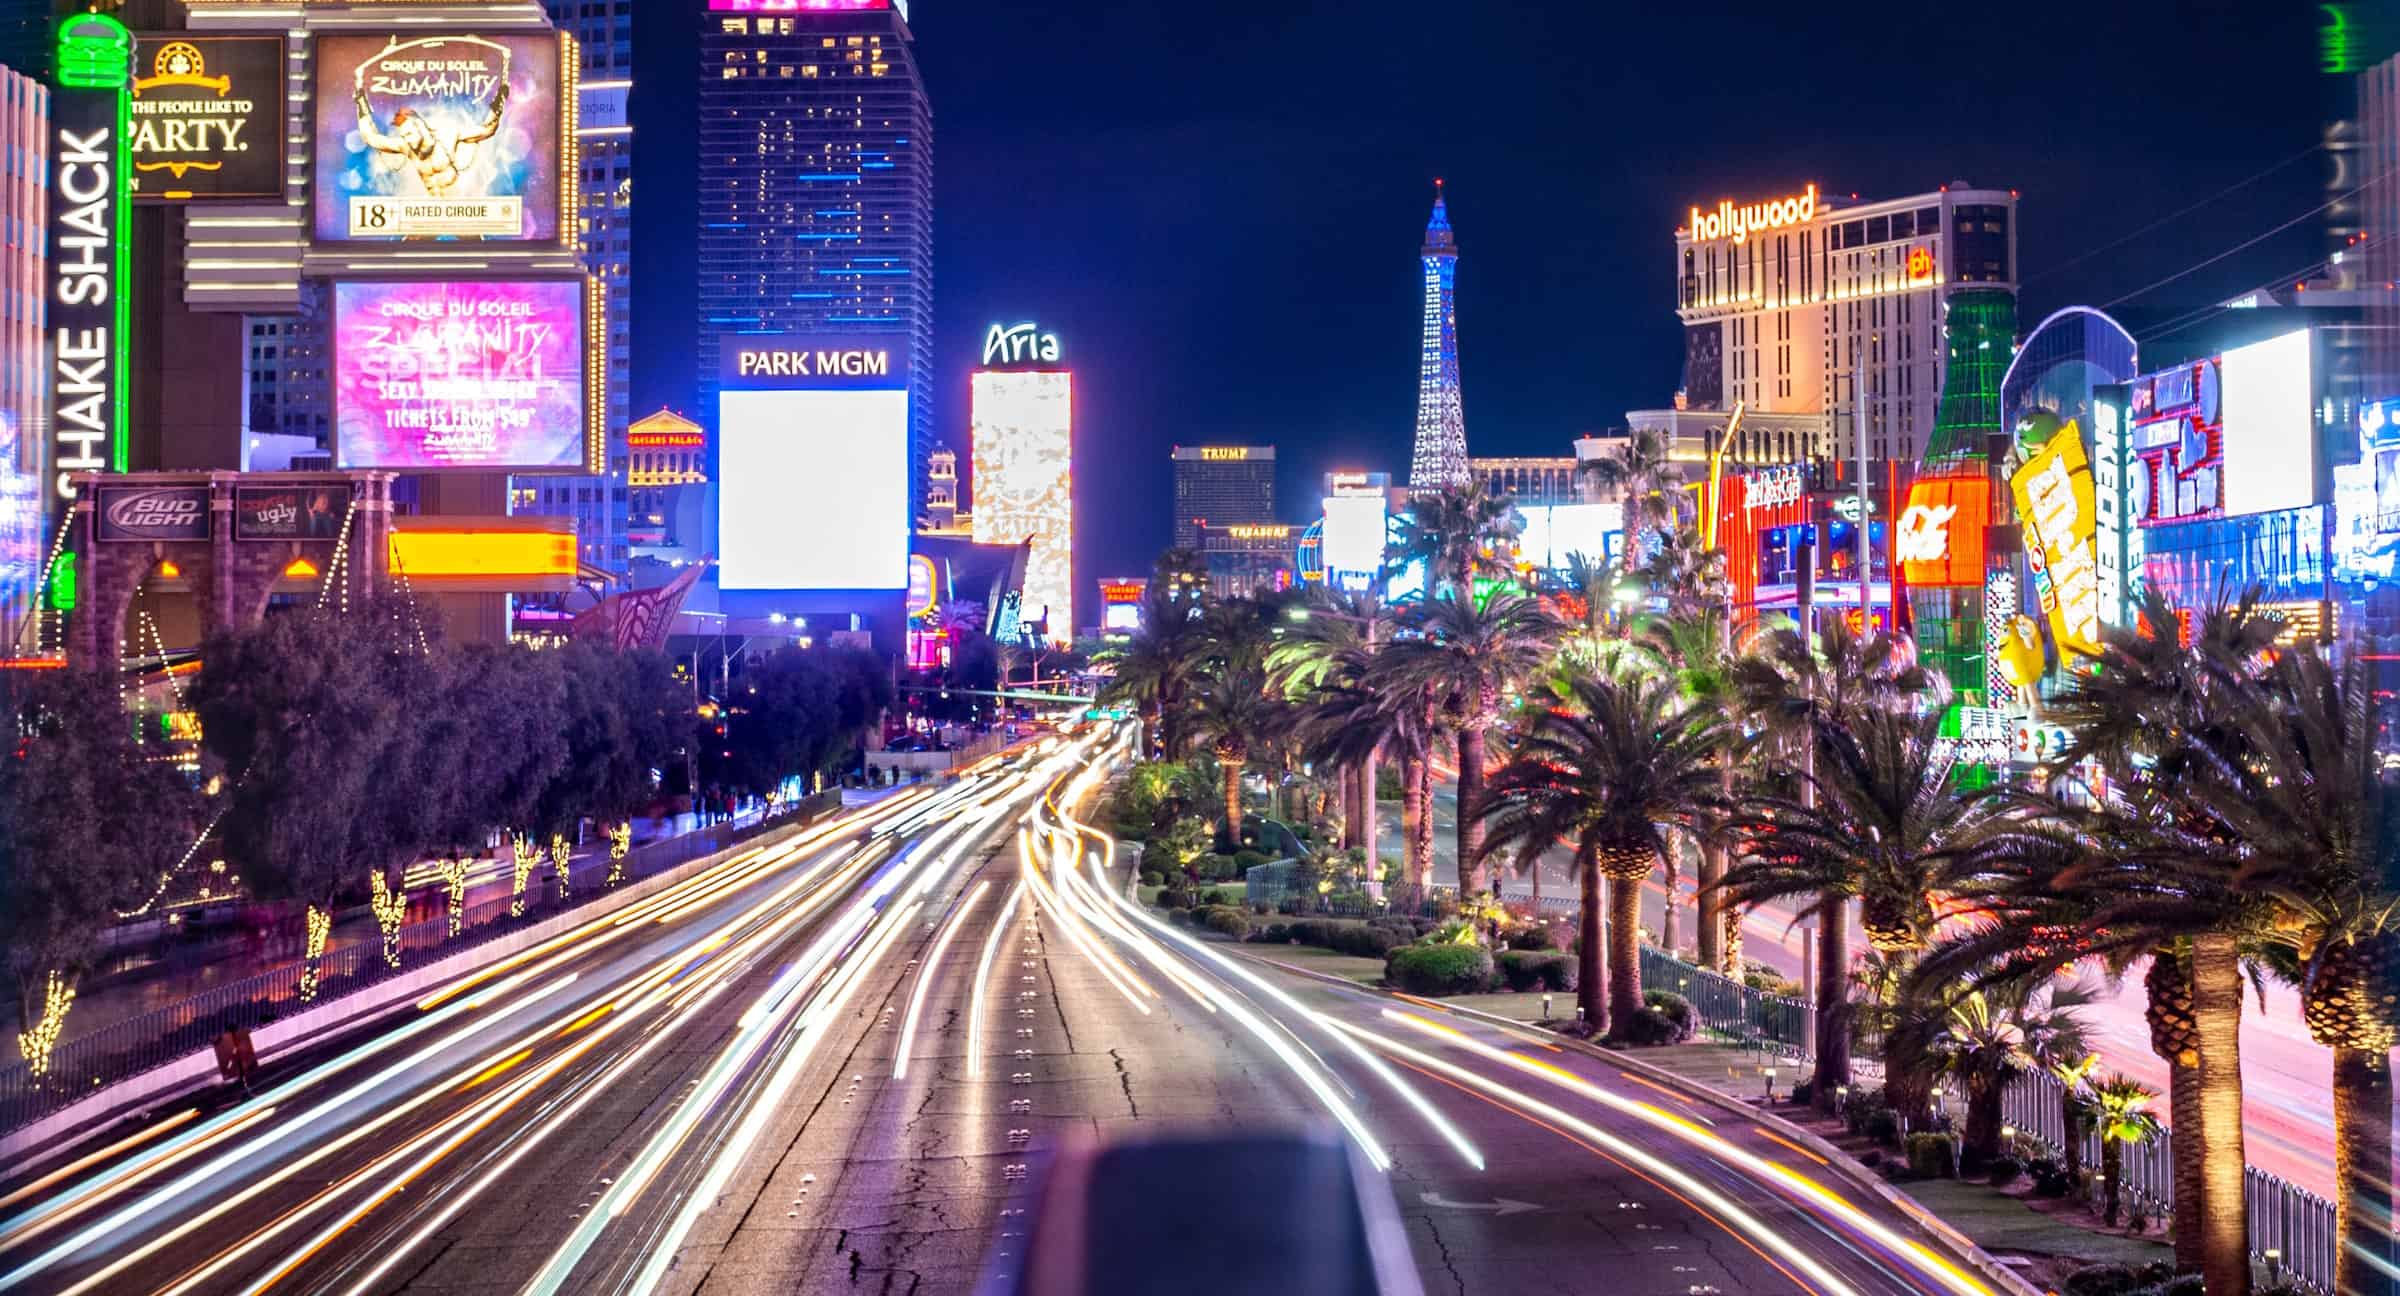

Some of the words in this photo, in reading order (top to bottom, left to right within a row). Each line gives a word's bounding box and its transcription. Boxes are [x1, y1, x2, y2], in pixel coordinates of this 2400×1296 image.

[381, 60, 425, 74] CIRQUE
[427, 60, 445, 71] DU
[447, 60, 488, 71] SOLEIL
[370, 72, 498, 104] ZUMANITY
[131, 100, 156, 113] THE
[158, 100, 204, 113] PEOPLE
[204, 100, 232, 113] LIKE
[234, 100, 253, 113] TO
[59, 127, 110, 306] SHACK
[405, 205, 442, 218] RATED
[446, 205, 488, 218] CIRQUE
[1691, 184, 1815, 245] hollywood
[381, 302, 444, 320] CIRQUE
[450, 302, 474, 316] DU
[478, 302, 536, 316] SOLEIL
[982, 322, 1060, 366] Aria
[739, 351, 810, 376] PARK
[816, 351, 888, 376] MGM
[1201, 447, 1248, 460] TRUMP
[135, 500, 199, 513] BUD
[257, 504, 297, 525] ugly
[2094, 399, 2121, 628] SKECHERS
[121, 512, 203, 526] LIGHT
